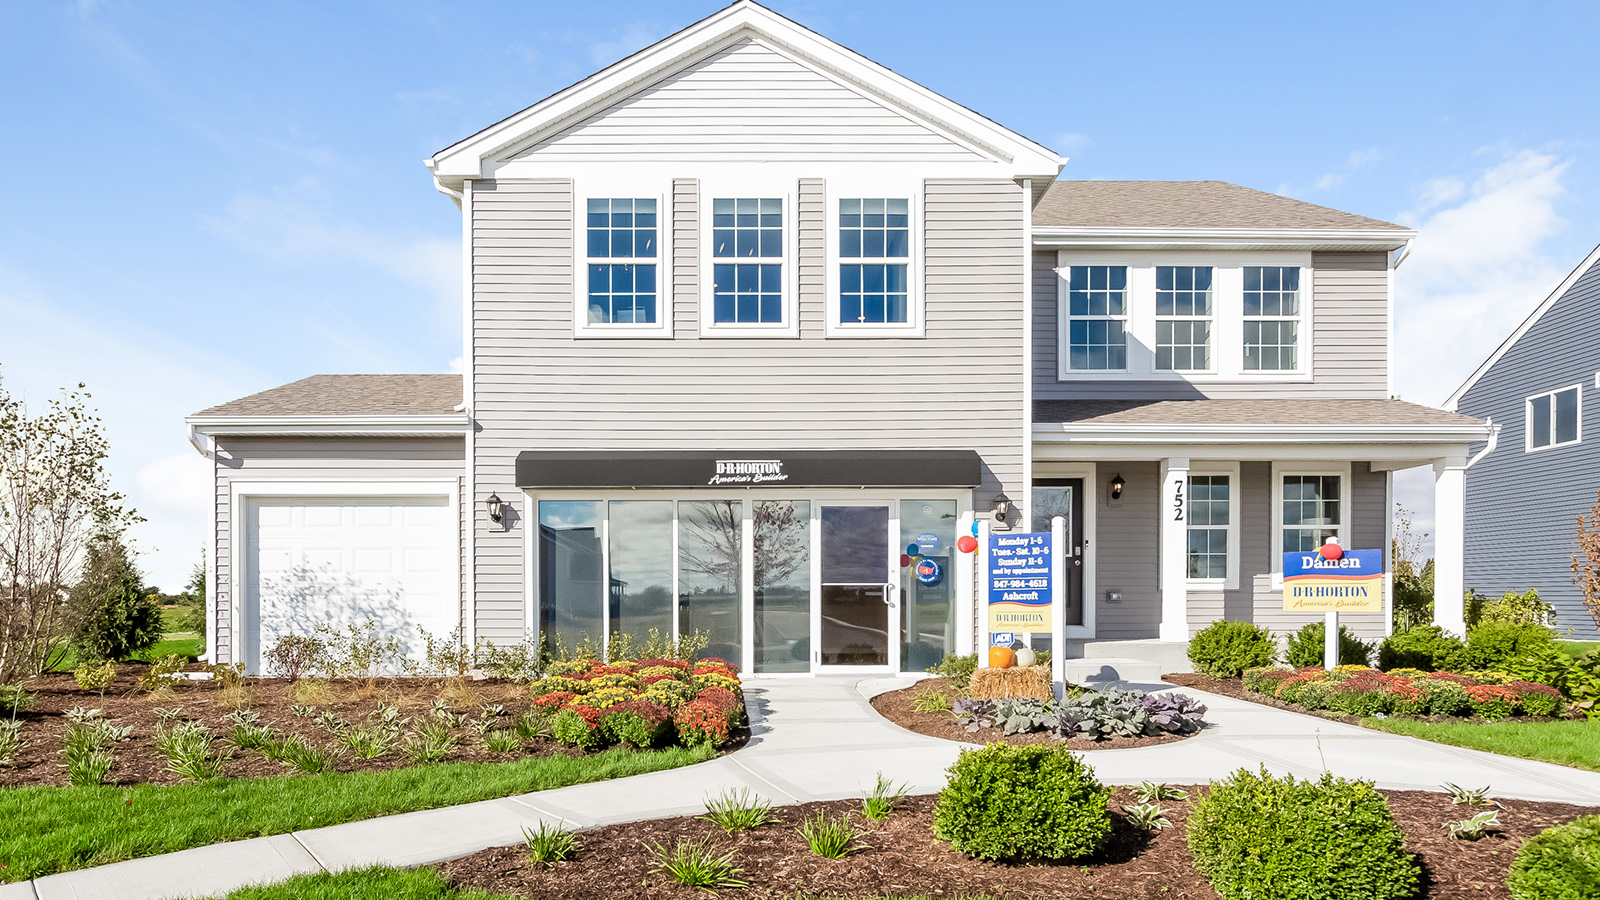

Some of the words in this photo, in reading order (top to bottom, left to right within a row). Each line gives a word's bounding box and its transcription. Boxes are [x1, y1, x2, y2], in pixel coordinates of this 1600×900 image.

[708, 475, 751, 485] America's
[752, 473, 788, 482] Builder
[1174, 480, 1184, 521] 752
[998, 537, 1029, 546] Monday
[1016, 547, 1030, 555] Sat.
[998, 557, 1027, 567] Sunday
[1028, 557, 1043, 565] 11-6
[1004, 567, 1011, 575] by
[1012, 567, 1048, 575] appointment
[1002, 591, 1039, 600] Ashcroft
[1293, 599, 1332, 608] America's
[1335, 599, 1369, 608] Builder
[996, 634, 1011, 642] ADT
